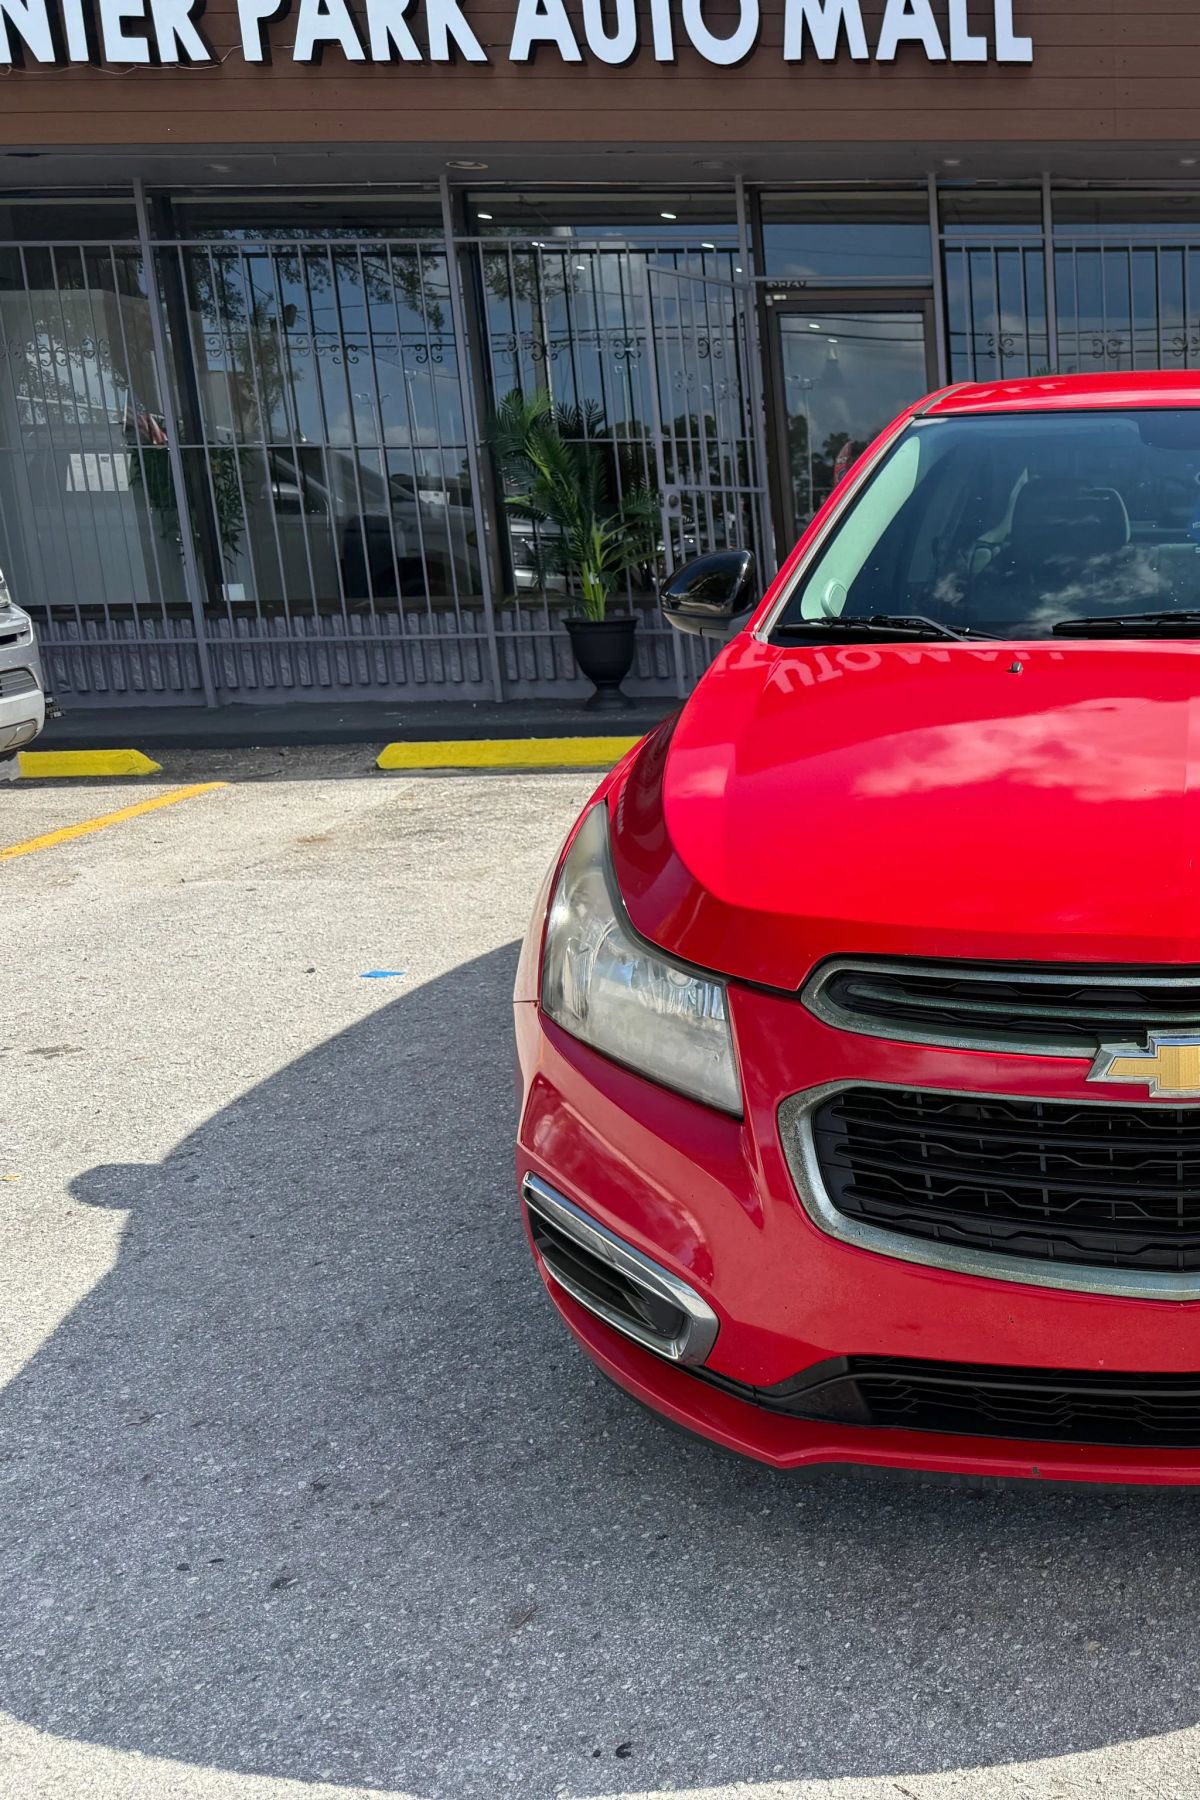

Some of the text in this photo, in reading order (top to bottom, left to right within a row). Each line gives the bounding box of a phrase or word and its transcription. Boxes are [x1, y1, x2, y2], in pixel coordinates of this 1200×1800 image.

[238, 0, 489, 62] PARK
[509, 0, 760, 65] AUTO
[783, 0, 1033, 62] MALL
